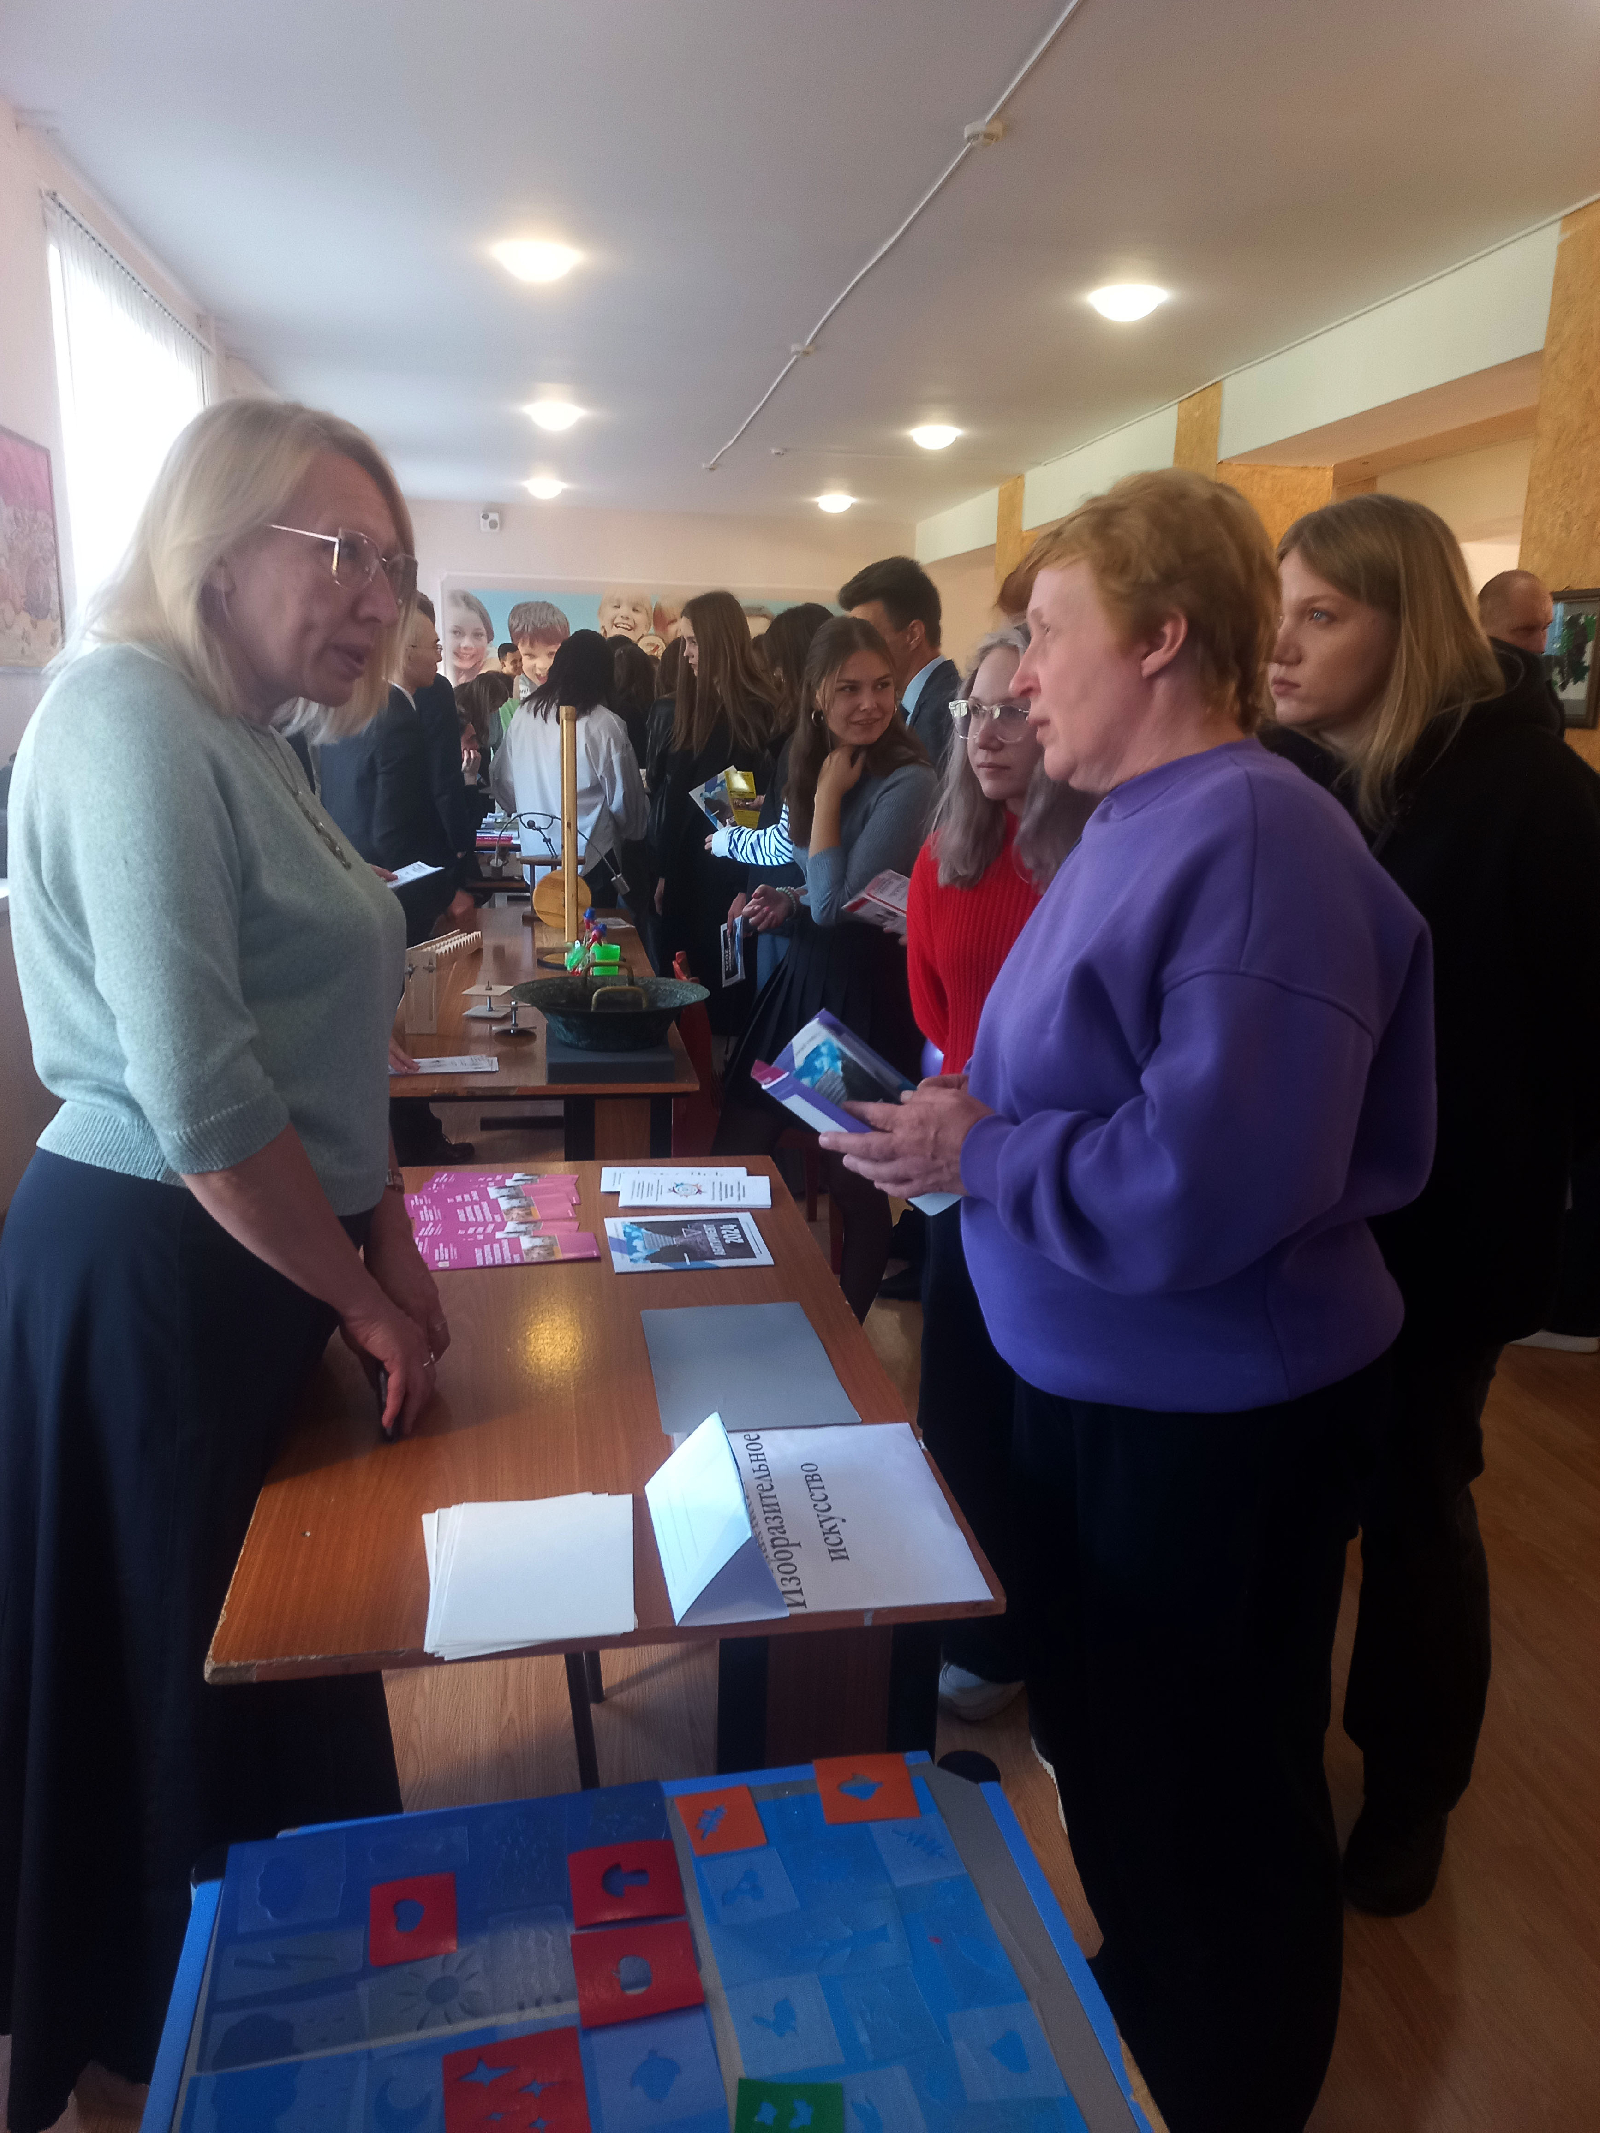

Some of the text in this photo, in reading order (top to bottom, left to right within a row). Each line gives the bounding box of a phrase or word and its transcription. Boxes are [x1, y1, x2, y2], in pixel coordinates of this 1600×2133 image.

[720, 1223, 745, 1244] 2024
[743, 1433, 808, 1609] Изобразительное
[801, 1463, 851, 1562] искусство
